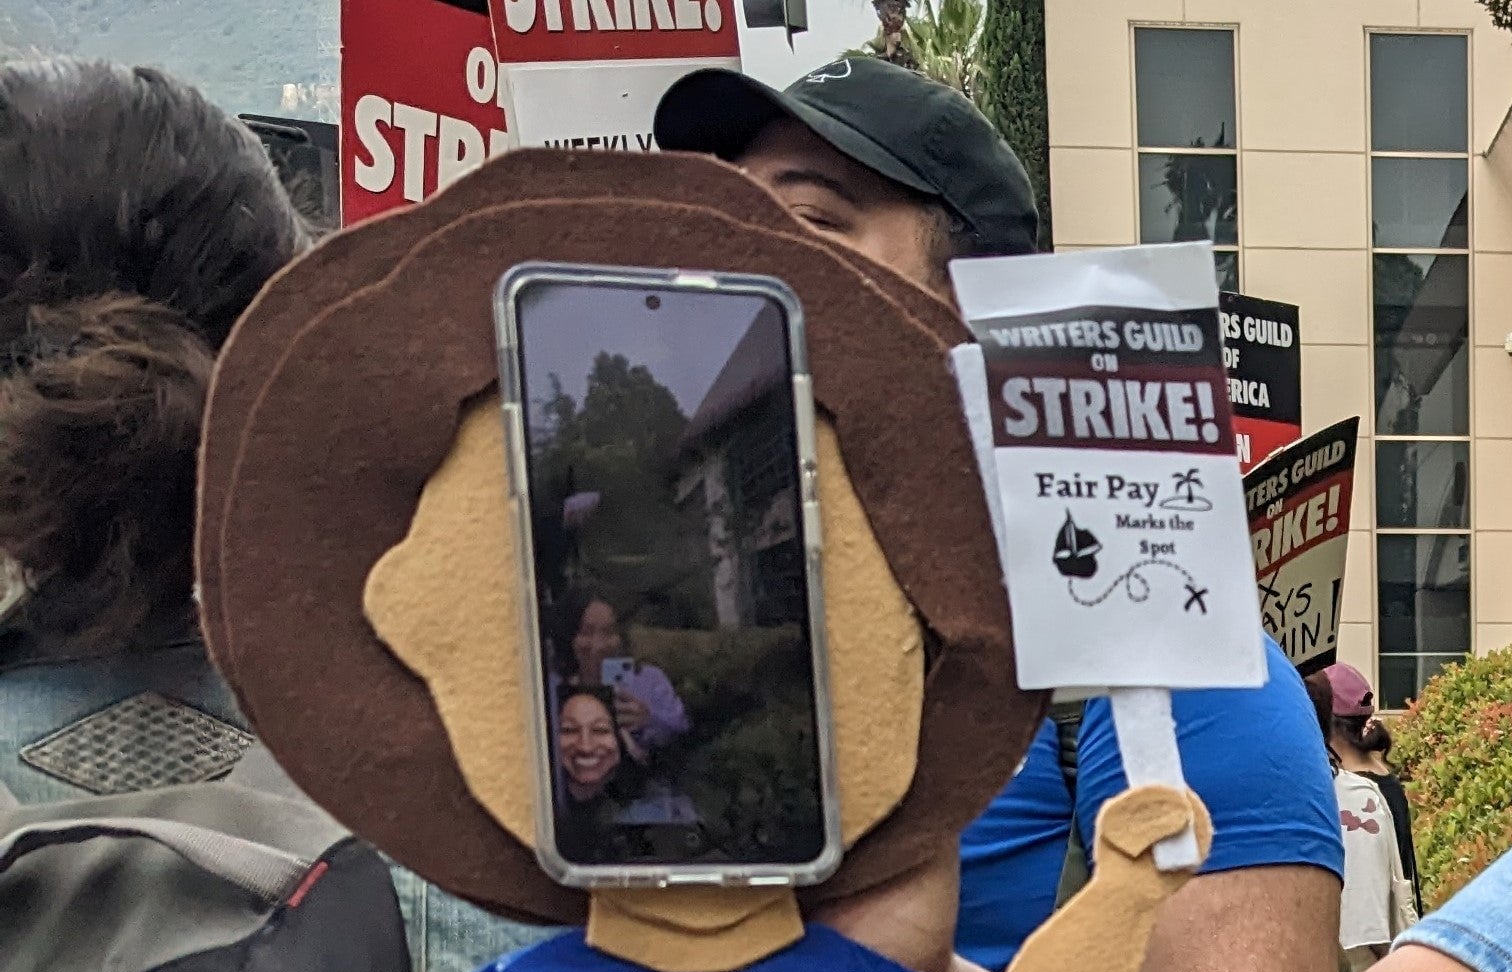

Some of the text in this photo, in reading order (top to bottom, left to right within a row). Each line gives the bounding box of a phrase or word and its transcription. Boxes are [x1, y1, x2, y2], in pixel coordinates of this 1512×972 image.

[466, 47, 504, 108] O
[990, 320, 1204, 352] WRITERS GUILD
[1244, 316, 1293, 348] GUILD
[1091, 352, 1118, 373] ON
[1002, 376, 1220, 443] STRIKE!
[1291, 440, 1346, 485] GUILD
[1035, 472, 1159, 507] Fair Pay
[1115, 514, 1195, 531] Marks the
[1267, 498, 1284, 520] ON
[1139, 539, 1176, 558] Spot
